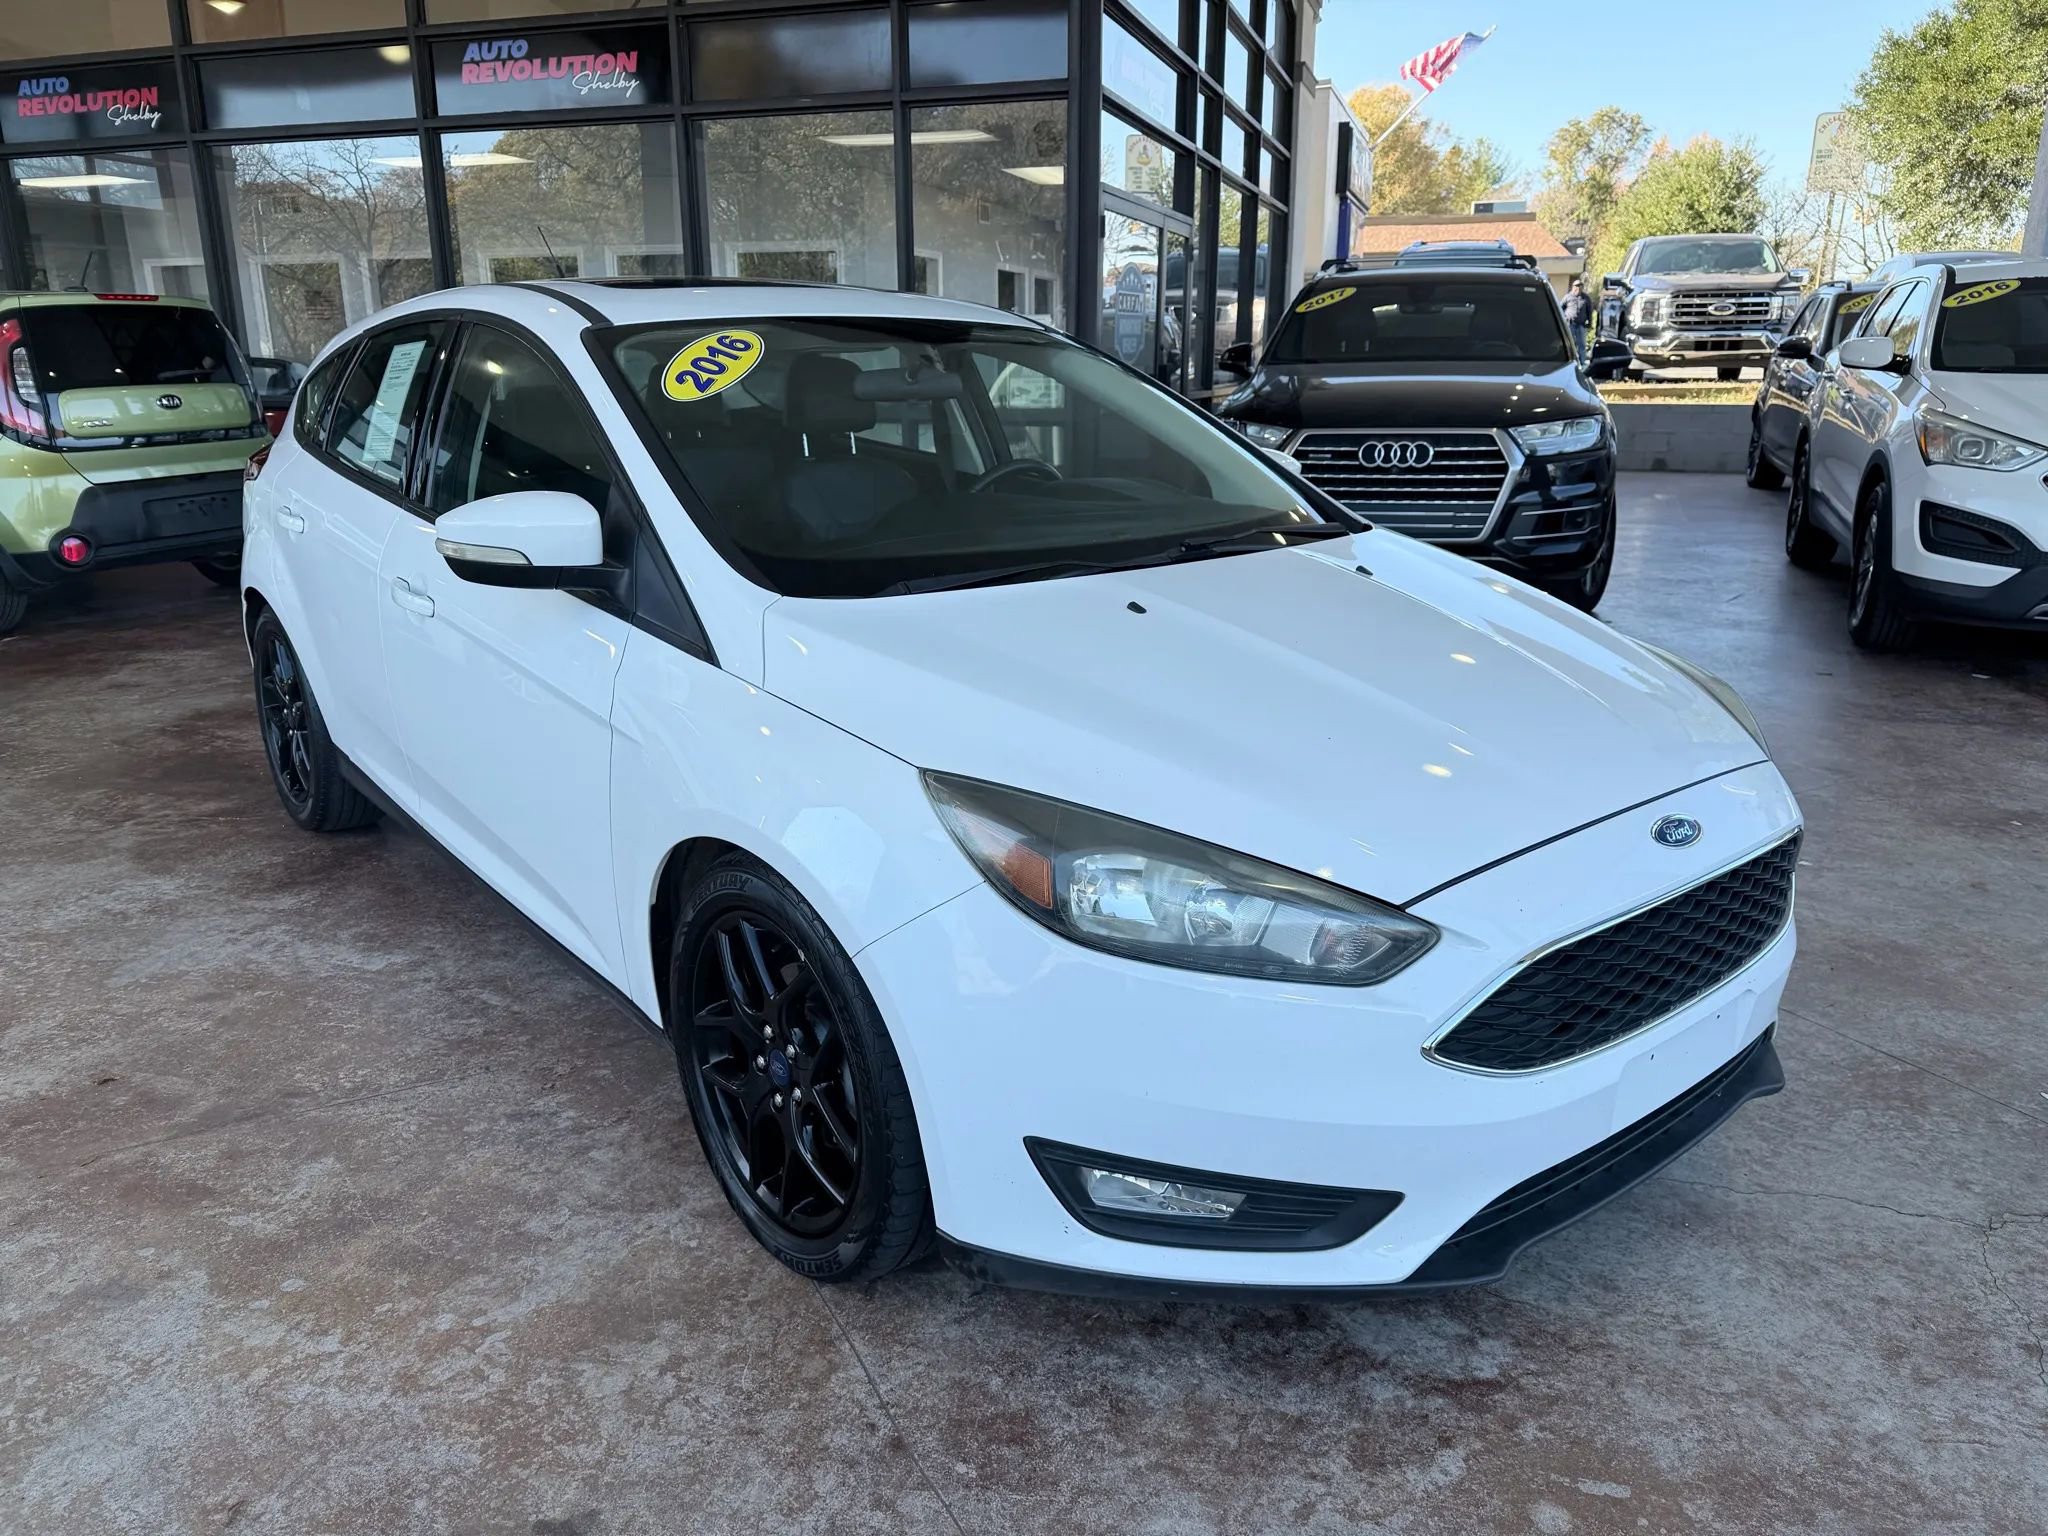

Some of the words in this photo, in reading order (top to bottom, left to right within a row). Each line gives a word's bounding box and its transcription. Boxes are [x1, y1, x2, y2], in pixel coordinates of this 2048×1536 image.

[463, 39, 528, 62] AUTO
[462, 51, 638, 84] REVOLUTION
[18, 77, 69, 96] AUTO
[572, 67, 640, 97] Shelby
[18, 86, 158, 116] REVOLUTION
[107, 101, 161, 128] Shelby
[1304, 289, 1346, 310] 2017
[1953, 282, 2010, 304] 2016
[675, 335, 754, 393] 2016
[1663, 821, 1693, 842] Ford
